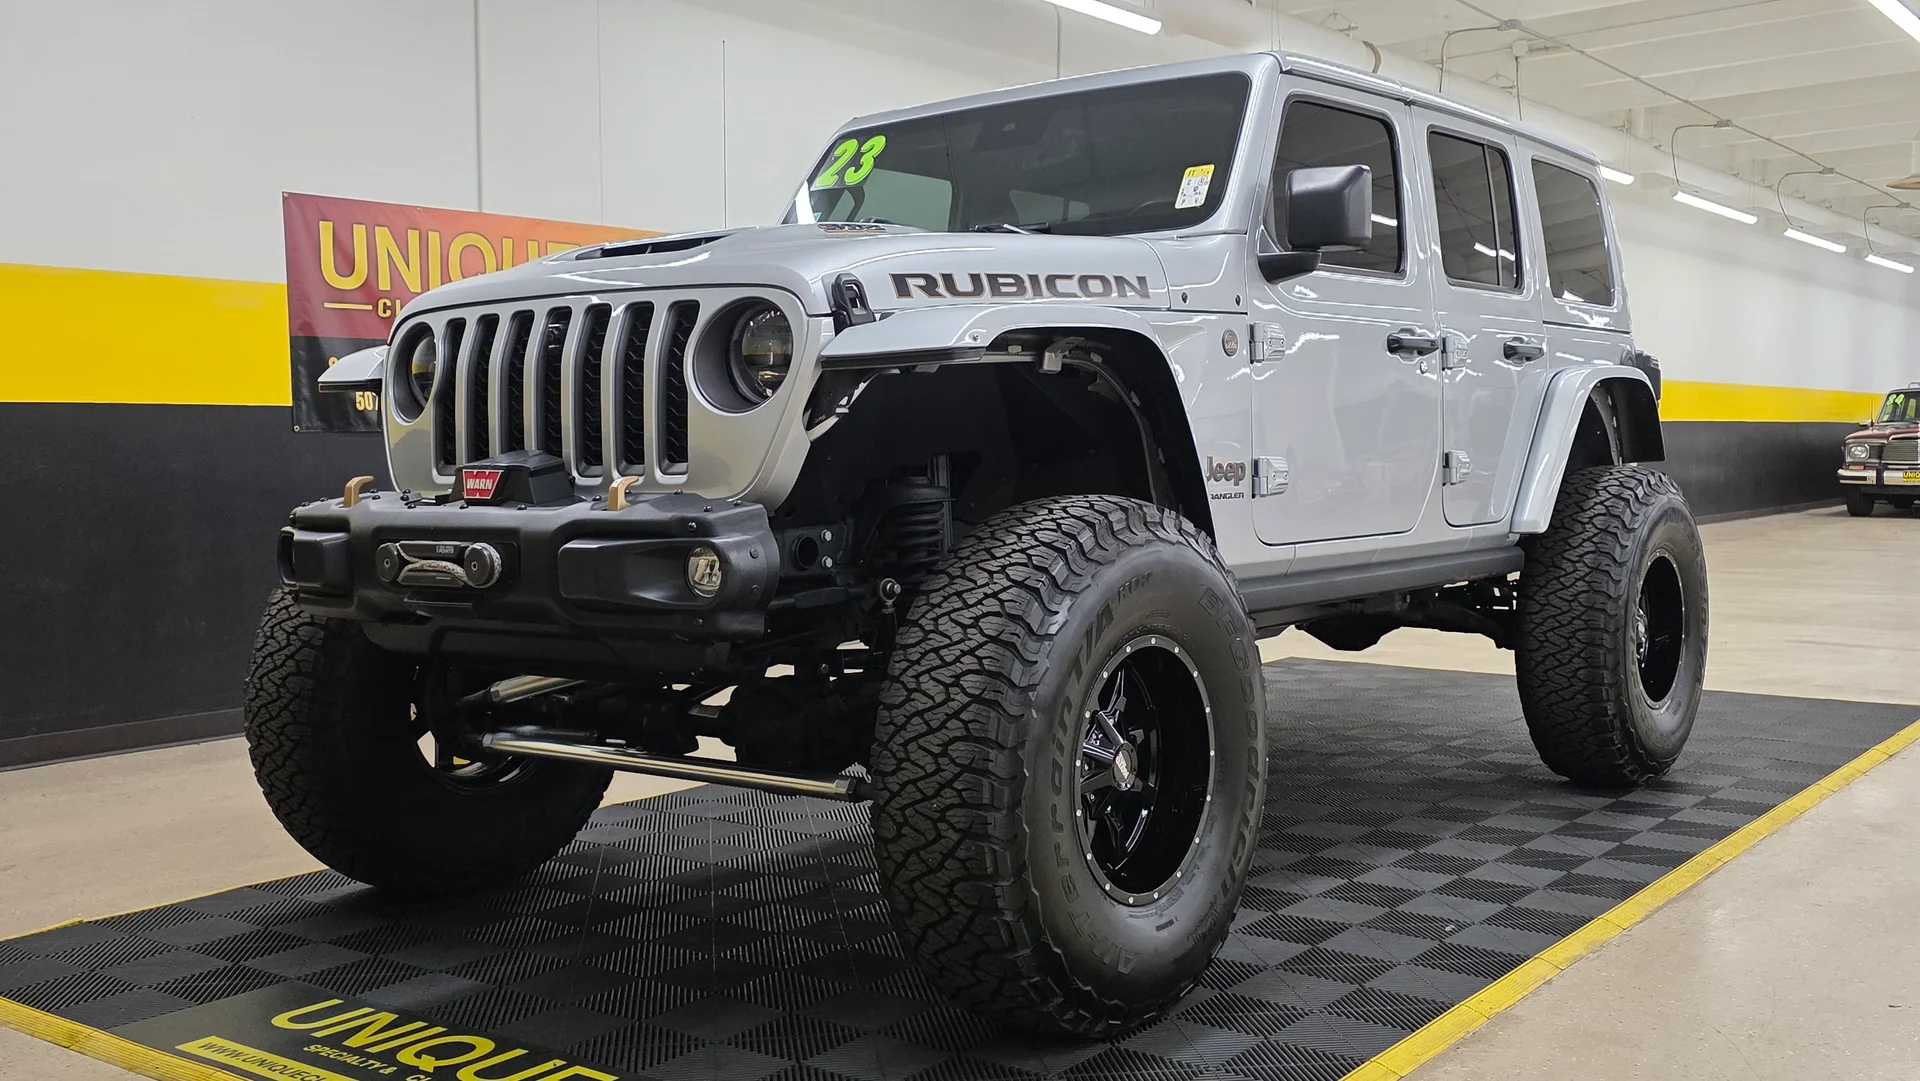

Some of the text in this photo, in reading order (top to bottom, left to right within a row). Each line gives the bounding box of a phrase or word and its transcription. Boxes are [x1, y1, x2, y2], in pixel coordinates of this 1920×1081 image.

[815, 134, 886, 186] 23
[318, 220, 581, 293] UNIQ
[889, 272, 1152, 300] RUBICON
[466, 478, 493, 490] WARN
[1206, 455, 1247, 487] Jeep
[1209, 492, 1245, 500] RANGLER
[303, 1044, 388, 1070] SPECIALTY
